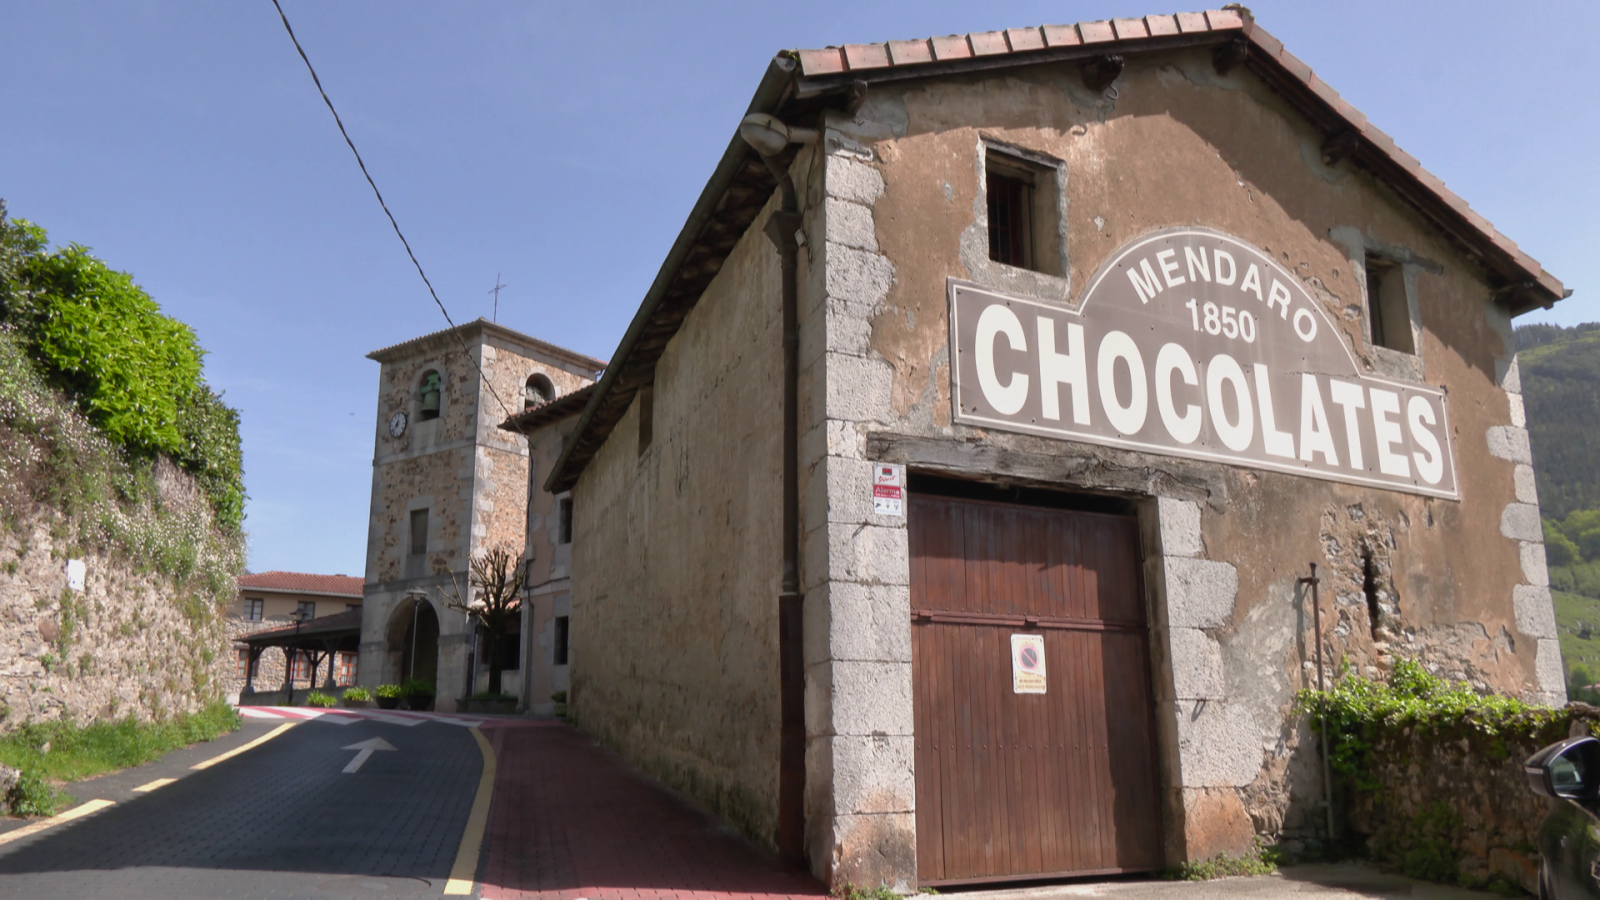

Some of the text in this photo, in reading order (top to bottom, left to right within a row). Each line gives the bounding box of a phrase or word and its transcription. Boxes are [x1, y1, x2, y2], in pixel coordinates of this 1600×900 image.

[1126, 246, 1318, 342] MENDARO
[1185, 298, 1256, 344] 1850
[975, 304, 1444, 485] CHOCOLATES
[875, 486, 900, 495] Alarma
